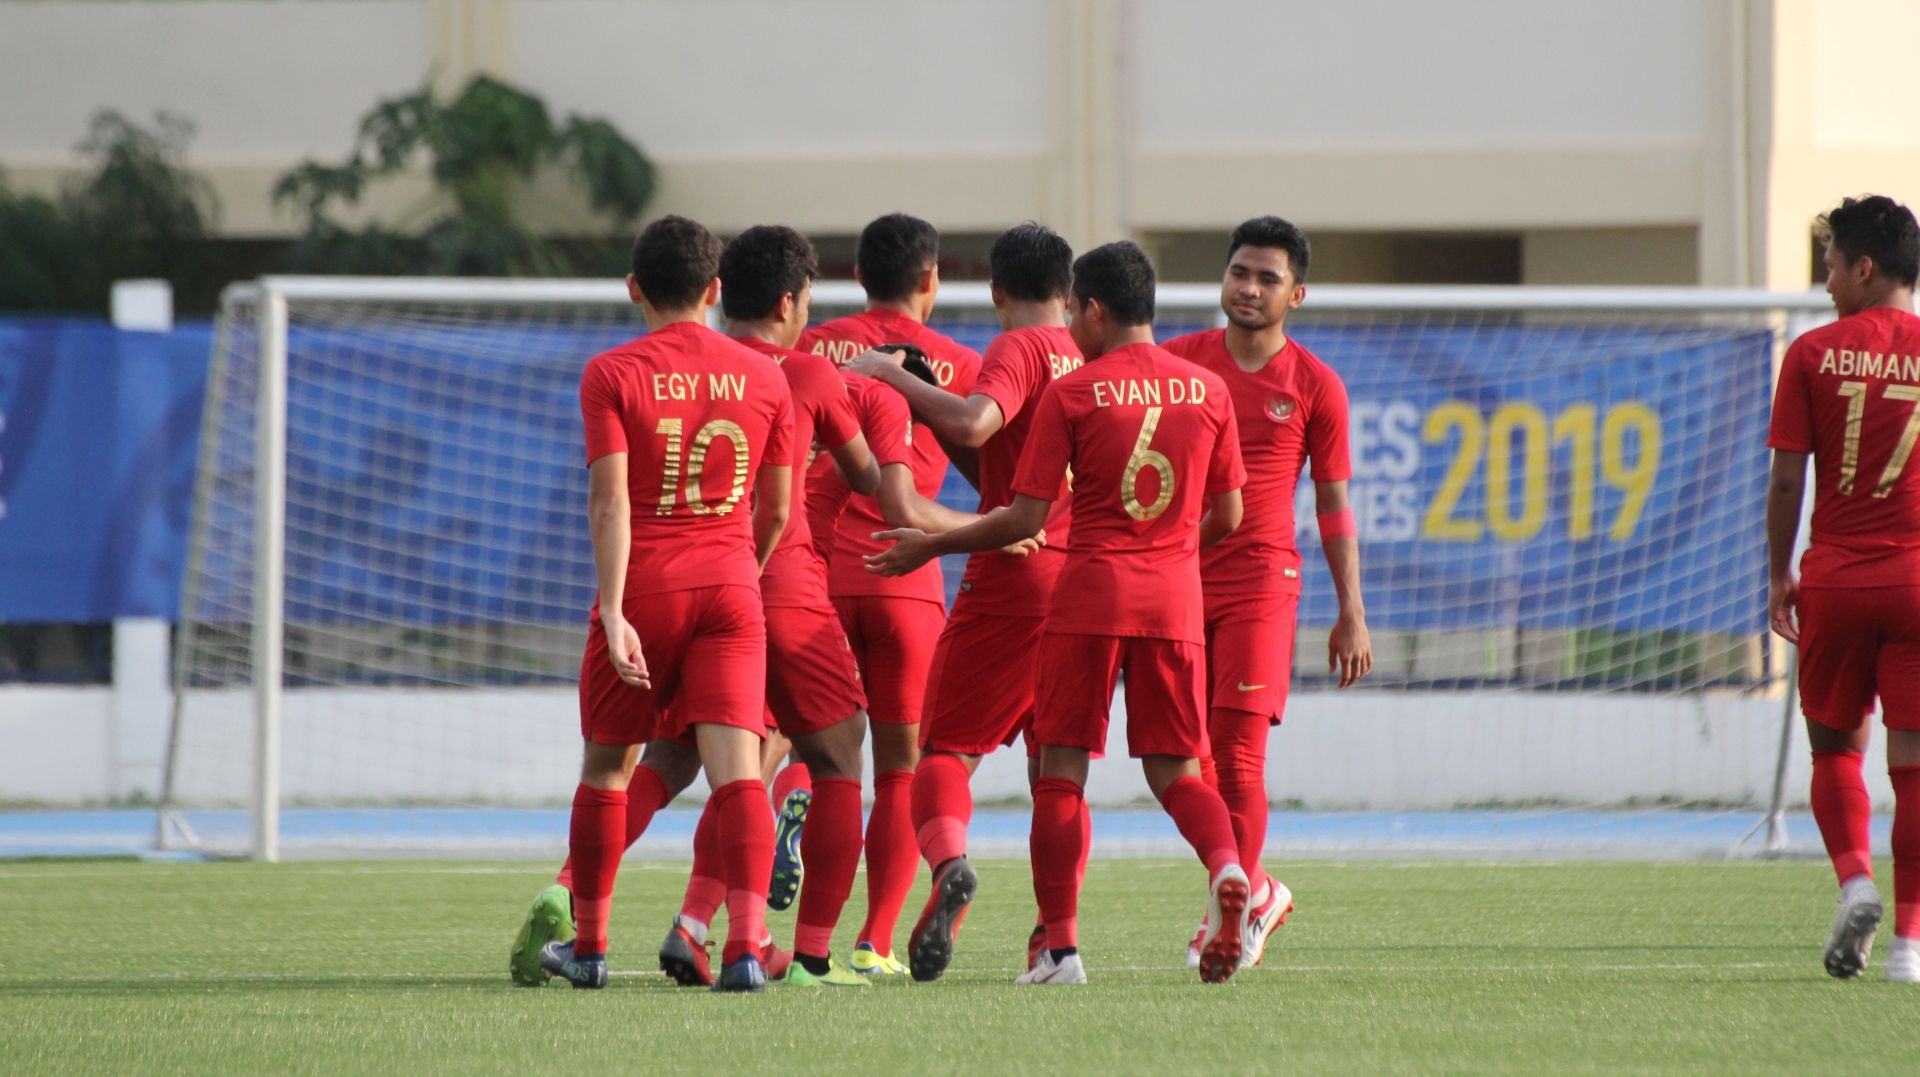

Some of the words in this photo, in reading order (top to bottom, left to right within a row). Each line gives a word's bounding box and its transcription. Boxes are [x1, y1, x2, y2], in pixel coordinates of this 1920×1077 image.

[653, 373, 699, 401] EGY
[709, 374, 746, 401] MV
[1093, 378, 1162, 407] EVAN
[1169, 378, 1206, 405] D.D
[1819, 348, 1920, 382] ABIMAN
[655, 418, 749, 516] 10
[1120, 406, 1175, 521] 6
[1421, 401, 1663, 542] 2019
[1837, 380, 1920, 498] 17
